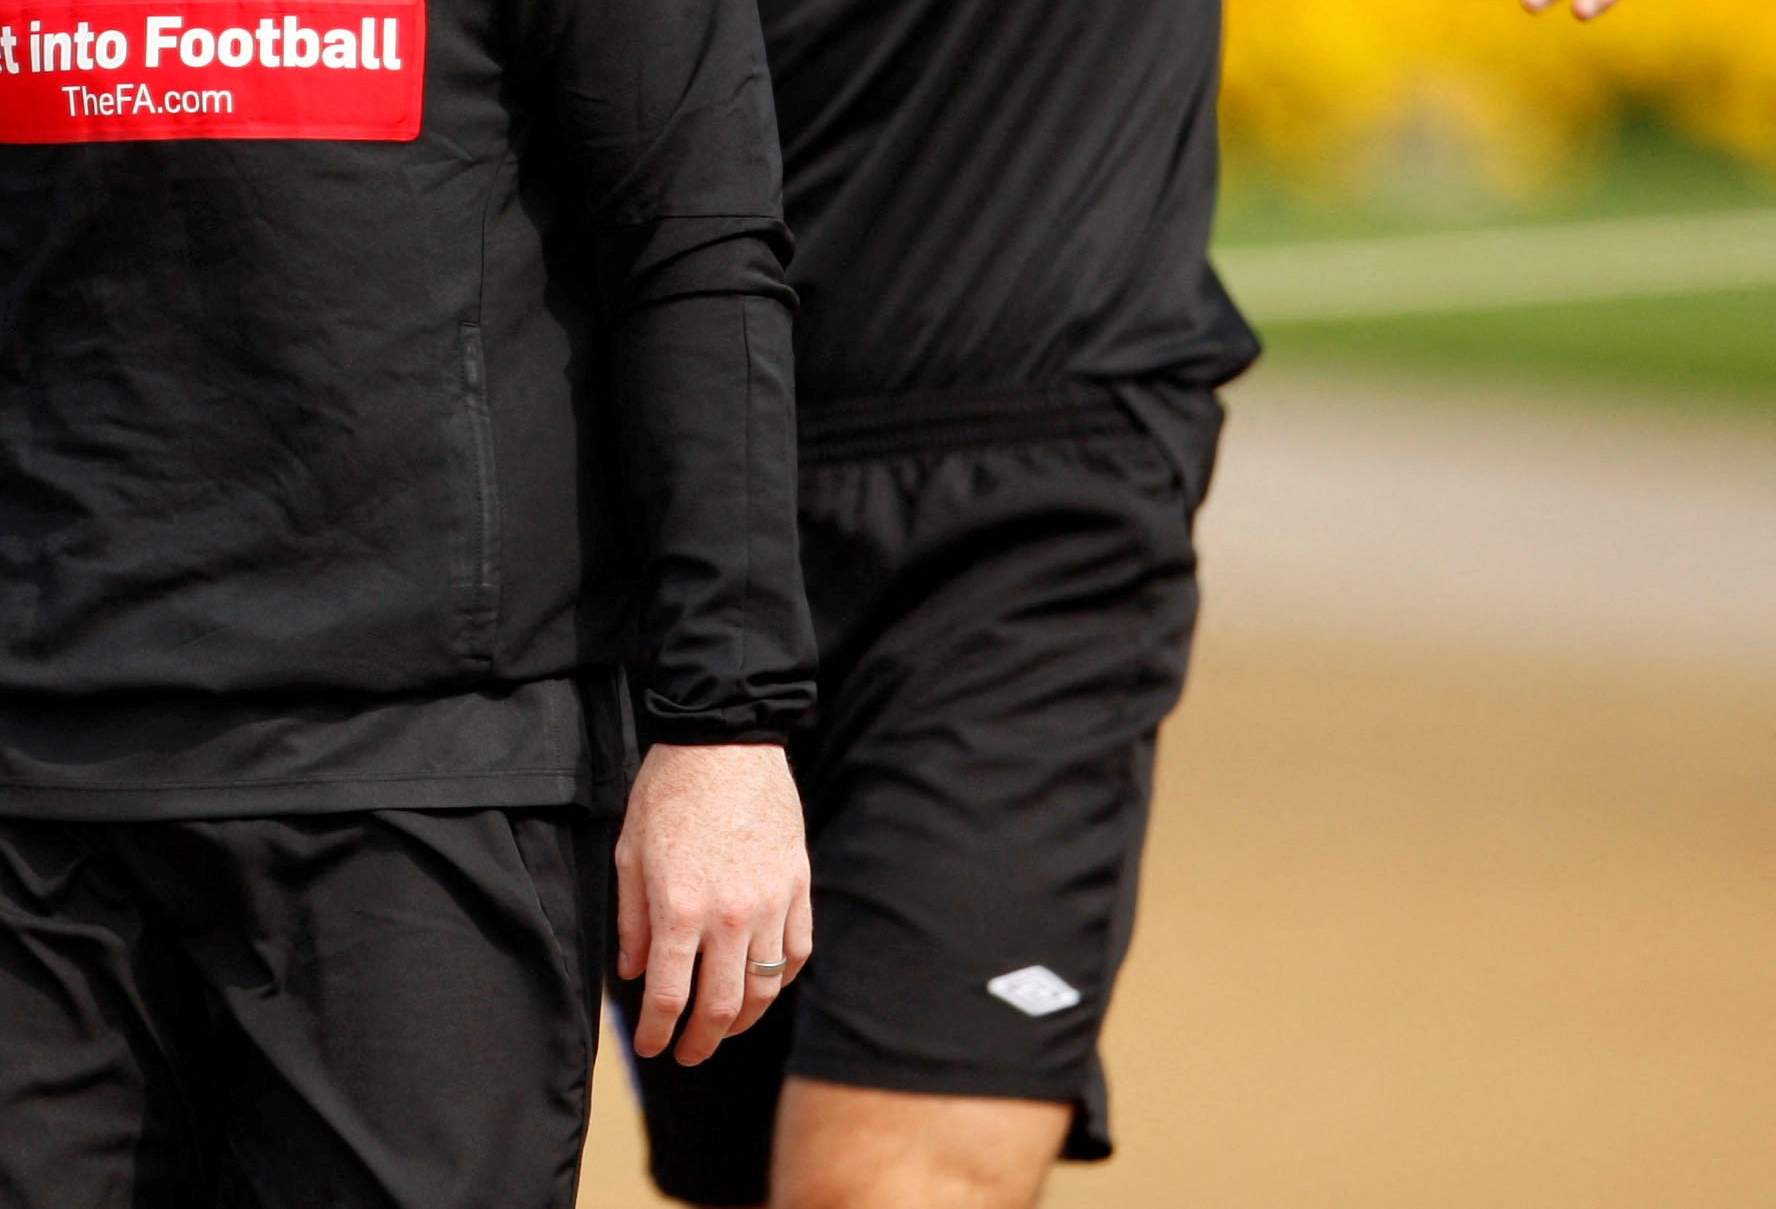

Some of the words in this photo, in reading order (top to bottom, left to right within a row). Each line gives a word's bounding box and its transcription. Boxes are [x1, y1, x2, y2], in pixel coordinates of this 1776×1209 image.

[29, 19, 129, 73] into
[144, 14, 403, 71] Football
[61, 82, 234, 117] TheFA.com
